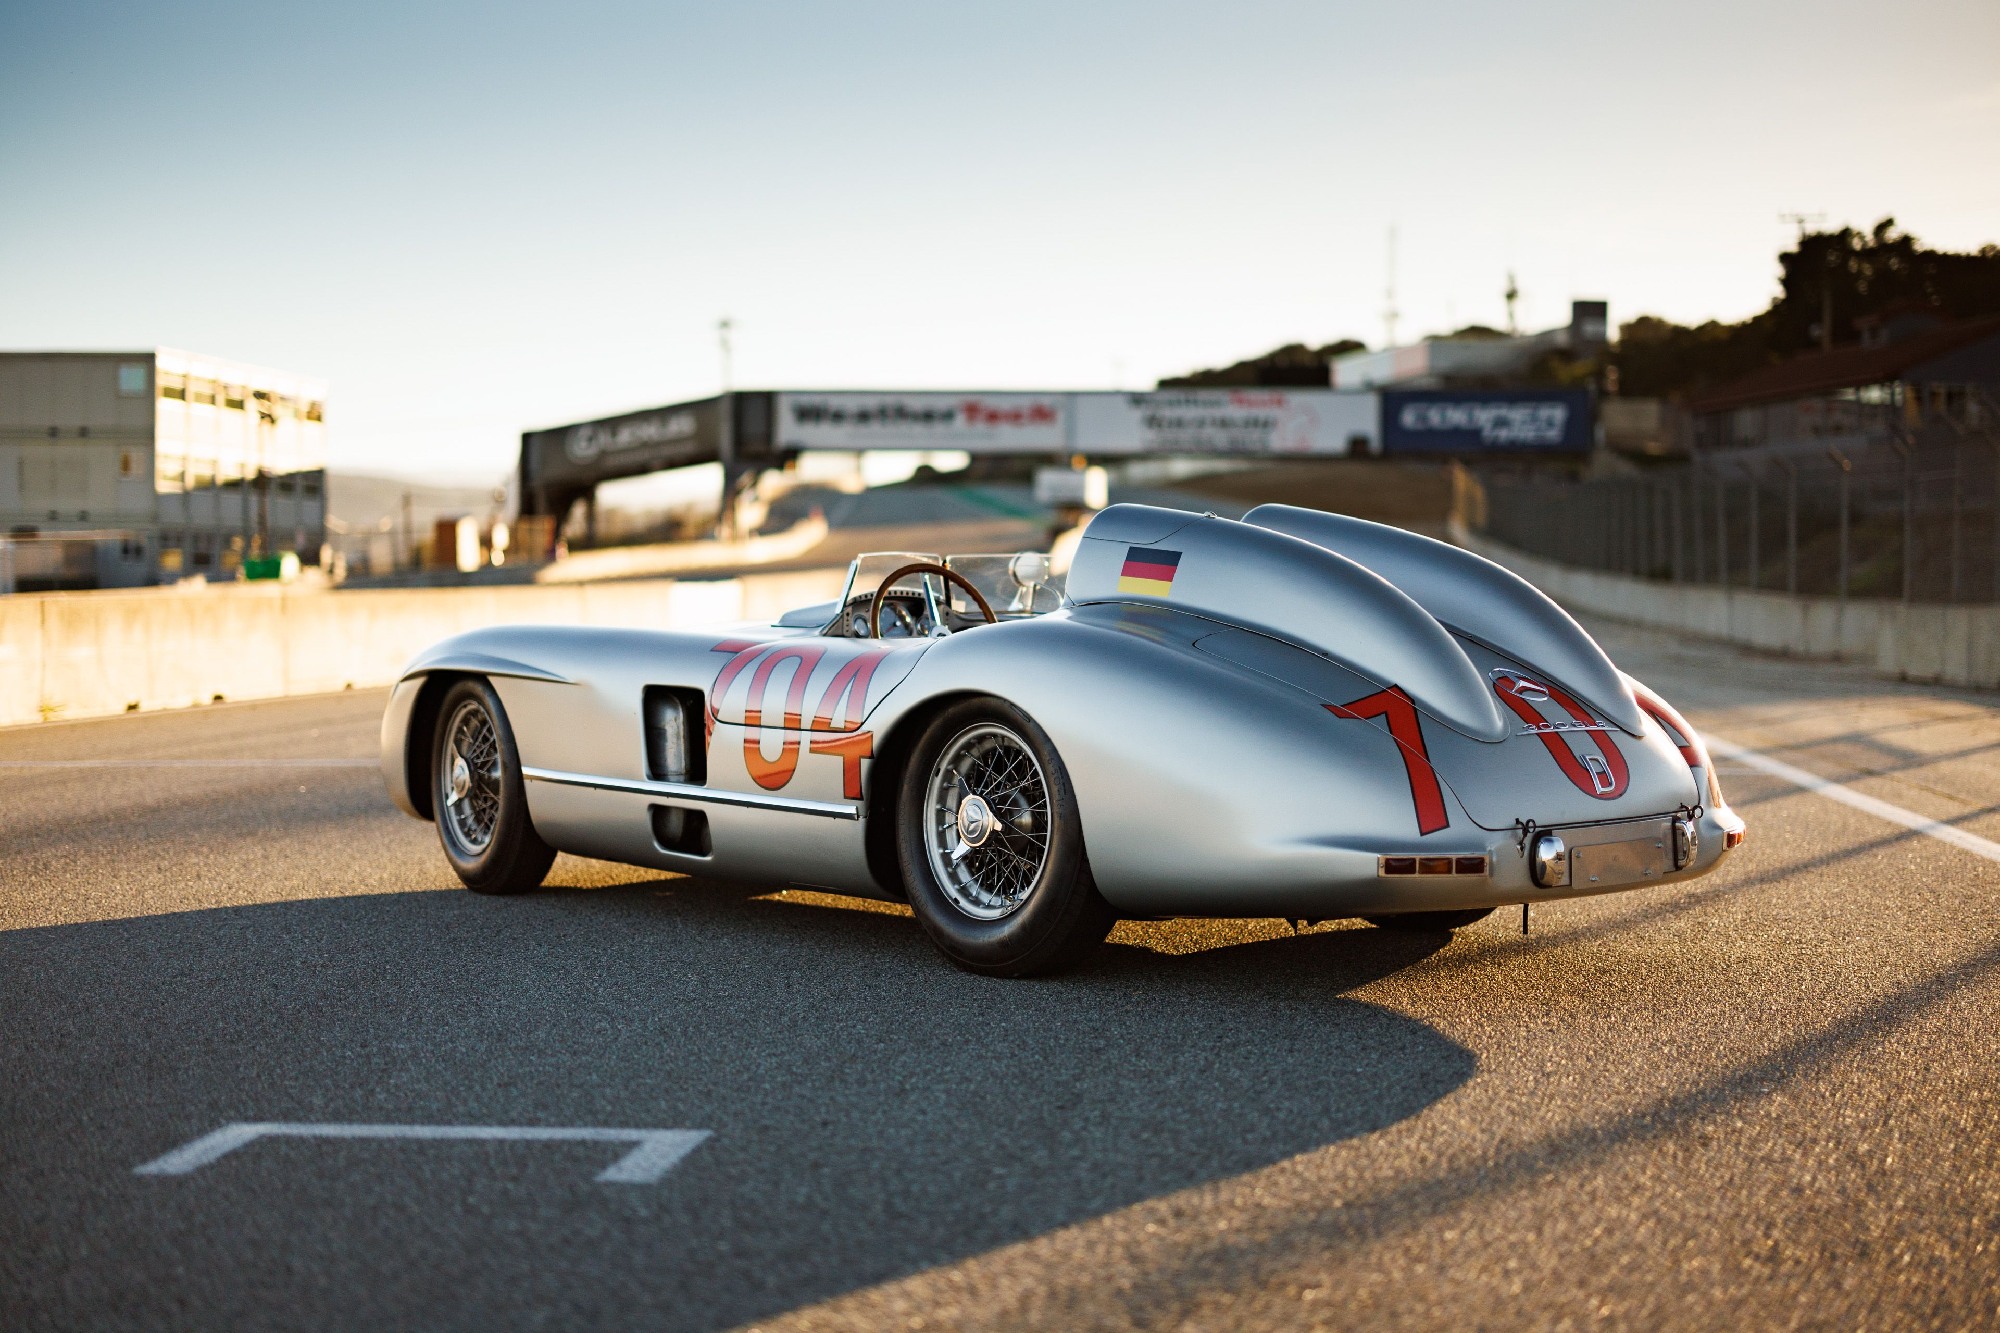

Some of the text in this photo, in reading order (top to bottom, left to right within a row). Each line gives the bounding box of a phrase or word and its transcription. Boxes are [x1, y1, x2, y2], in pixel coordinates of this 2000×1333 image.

[792, 400, 1058, 426] WeatherTech
[1400, 402, 1568, 430] COOPER
[1523, 720, 1607, 732] 300 SLR
[1580, 754, 1616, 795] D
